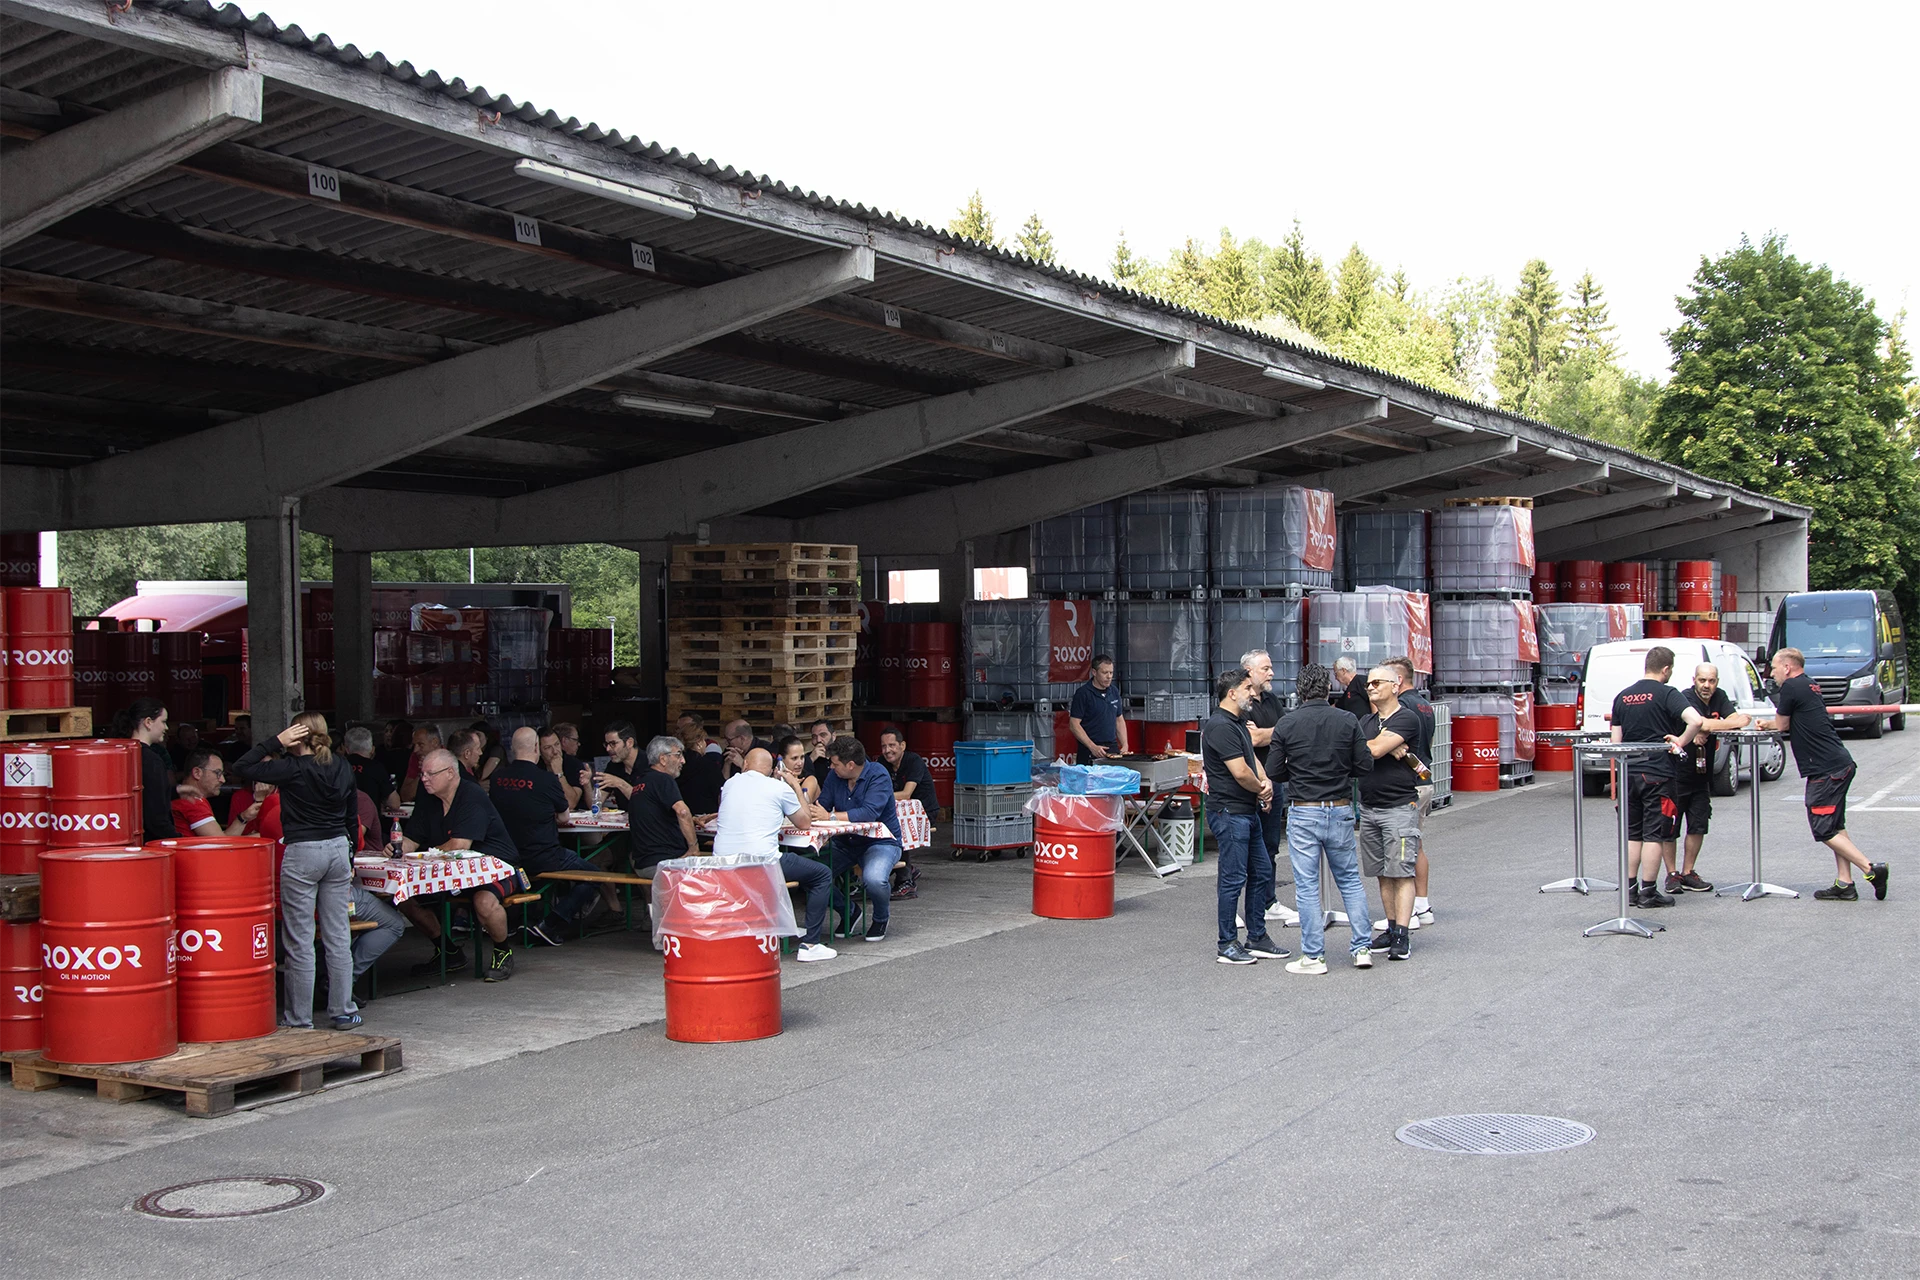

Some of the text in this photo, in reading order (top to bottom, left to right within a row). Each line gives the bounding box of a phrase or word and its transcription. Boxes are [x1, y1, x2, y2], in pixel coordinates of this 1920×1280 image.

[312, 172, 336, 192] 100
[517, 221, 537, 238] 101
[634, 249, 652, 265] 102
[886, 310, 899, 322] 104
[1064, 601, 1079, 637] R
[1622, 693, 1653, 704] ROXOR
[0, 811, 49, 828] OXO
[50, 813, 121, 831] ROXOR
[42, 943, 142, 970] ROXOR
